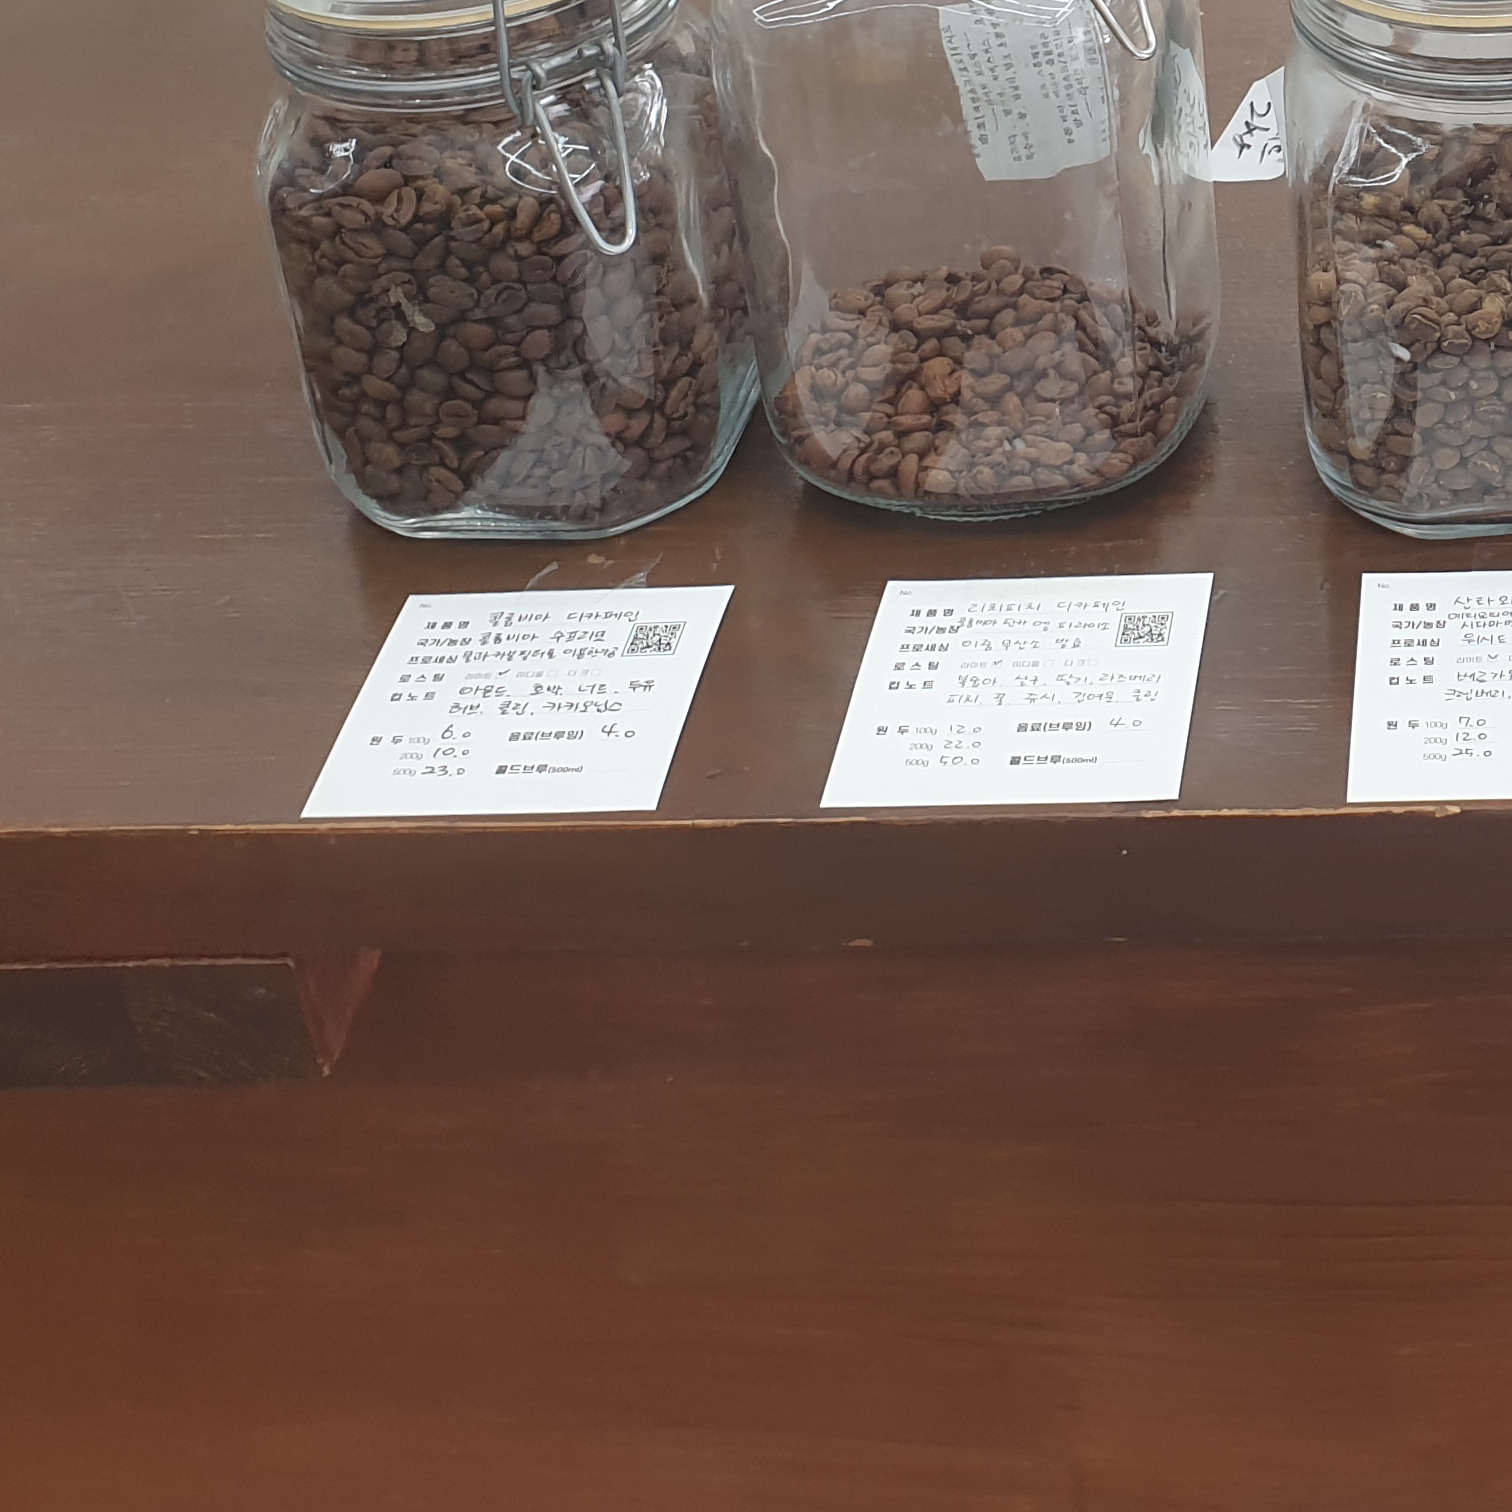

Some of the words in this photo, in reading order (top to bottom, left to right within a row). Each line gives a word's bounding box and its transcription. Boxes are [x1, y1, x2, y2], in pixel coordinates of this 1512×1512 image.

[1057, 600, 1126, 612] 디카페인
[566, 610, 640, 622] 디카페인
[949, 725, 982, 734] 12.0
[1109, 717, 1142, 729] 4.0
[1459, 716, 1487, 728] 7.0
[440, 724, 472, 740] 6.0
[601, 723, 636, 738] 4.0
[1455, 732, 1488, 742] 12.0
[943, 739, 981, 749] 22.0
[433, 748, 470, 759] 10.0
[1452, 747, 1492, 758] 25.0
[939, 755, 980, 766] 50.0
[420, 765, 465, 777] 23.0
